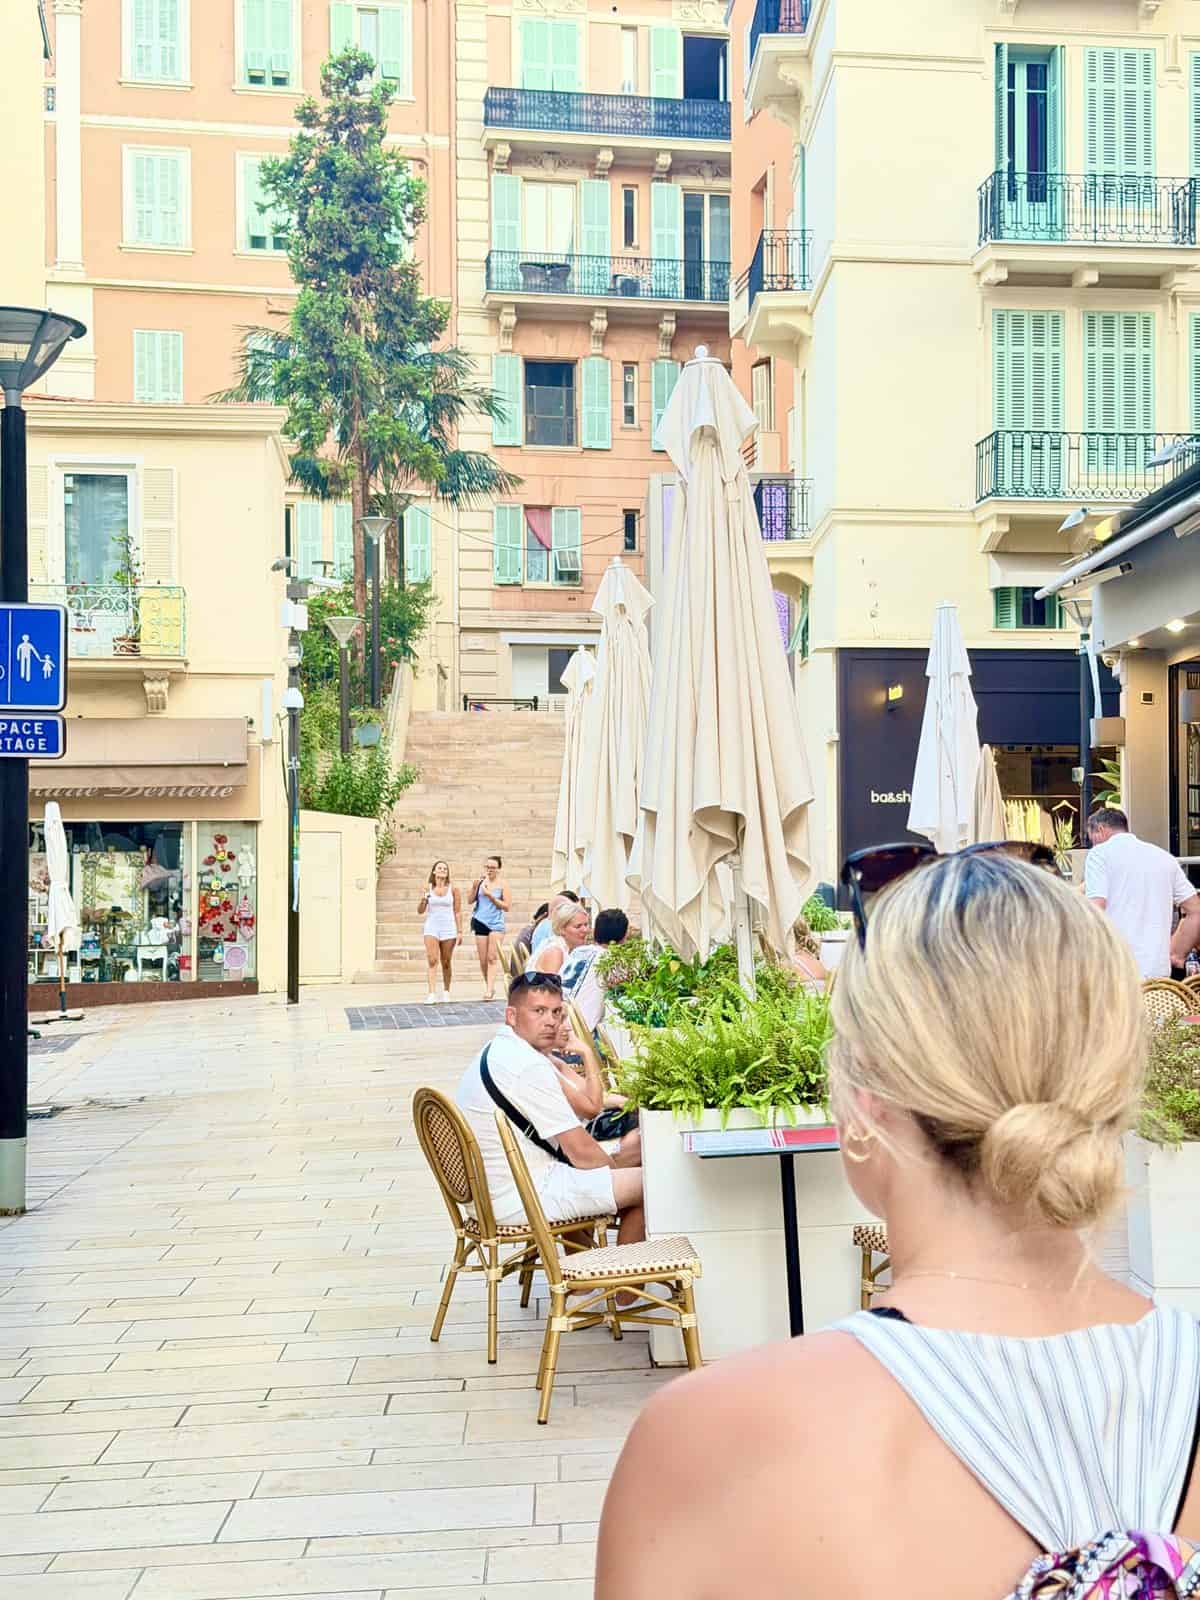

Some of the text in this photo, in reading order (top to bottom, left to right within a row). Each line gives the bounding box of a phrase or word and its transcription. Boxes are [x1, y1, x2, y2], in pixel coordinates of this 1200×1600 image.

[0, 721, 44, 735] PACE
[0, 737, 47, 751] TAGE
[870, 789, 912, 804] ba&sh
